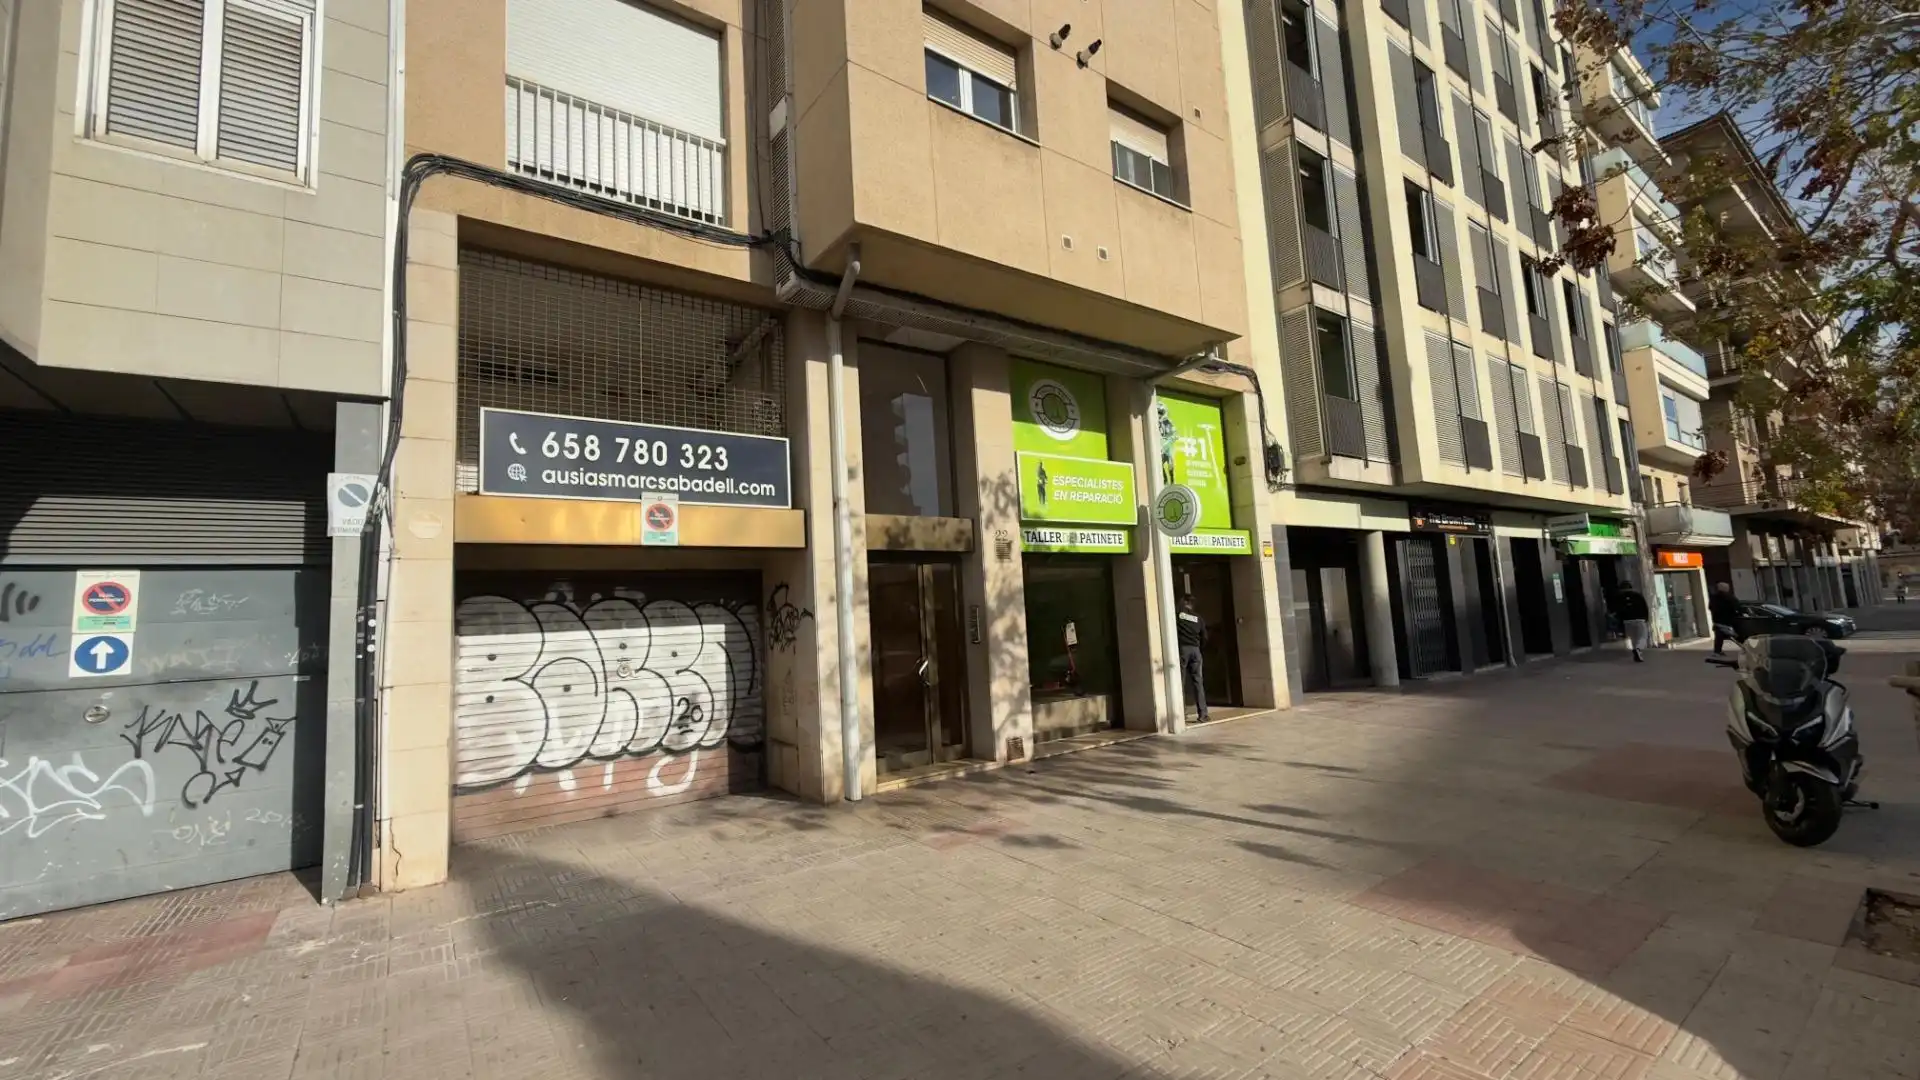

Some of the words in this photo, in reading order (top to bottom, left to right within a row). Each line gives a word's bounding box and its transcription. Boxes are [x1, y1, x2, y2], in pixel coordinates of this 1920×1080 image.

[541, 431, 601, 460] 658
[615, 437, 668, 466] 780
[679, 443, 728, 471] 323
[541, 467, 776, 496] ausiasmarcsabadell.com
[1053, 475, 1125, 491] ESPECIALISTES
[1054, 489, 1068, 501] EN
[994, 529, 1009, 542] 22
